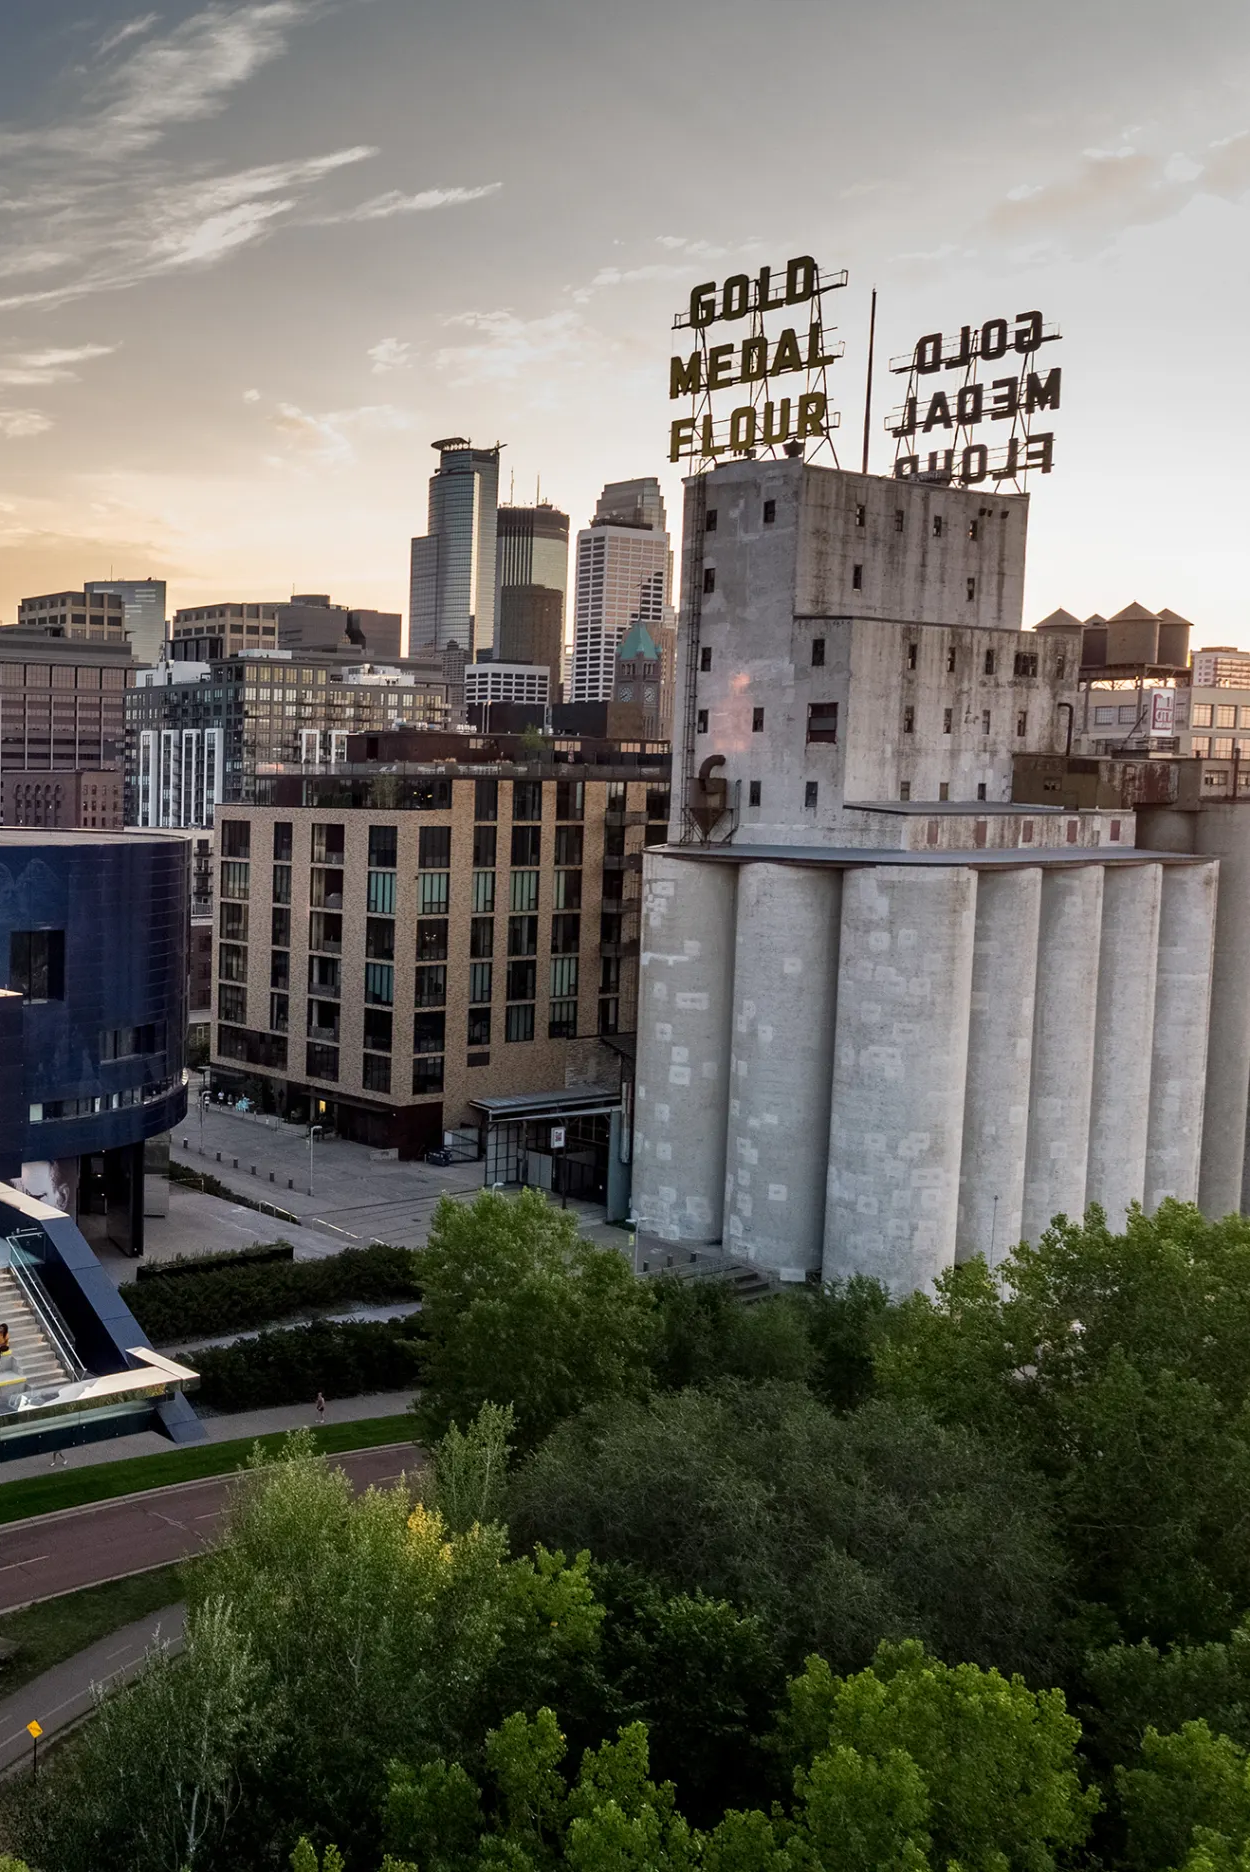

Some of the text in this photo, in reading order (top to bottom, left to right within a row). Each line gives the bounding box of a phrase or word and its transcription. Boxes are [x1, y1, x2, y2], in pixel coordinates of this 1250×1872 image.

[690, 255, 815, 329] GOLD
[669, 322, 835, 399] MEDAL
[669, 391, 827, 463] FLOUR
